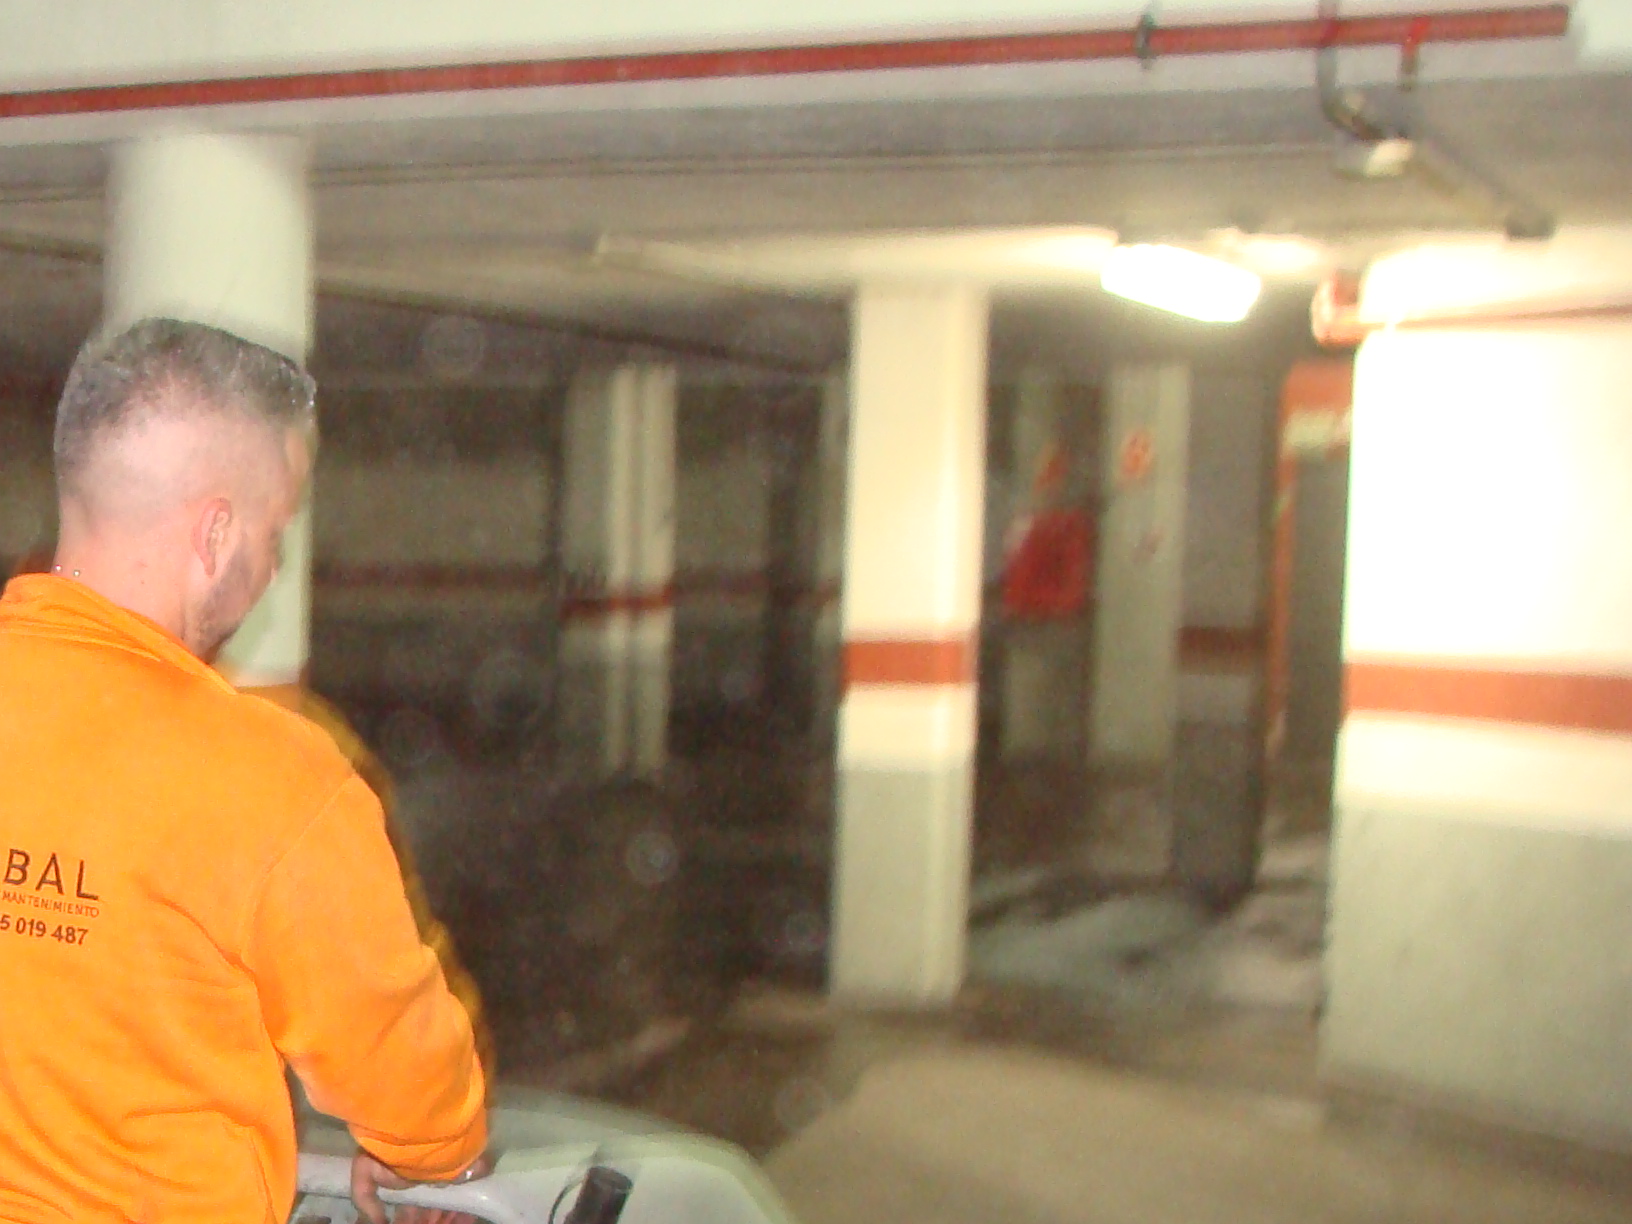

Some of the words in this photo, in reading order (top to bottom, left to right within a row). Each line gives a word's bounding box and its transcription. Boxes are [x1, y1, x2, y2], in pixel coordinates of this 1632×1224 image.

[1, 890, 100, 918] MANTENIMIENTO
[15, 916, 47, 938] 019
[50, 924, 89, 946] 487
